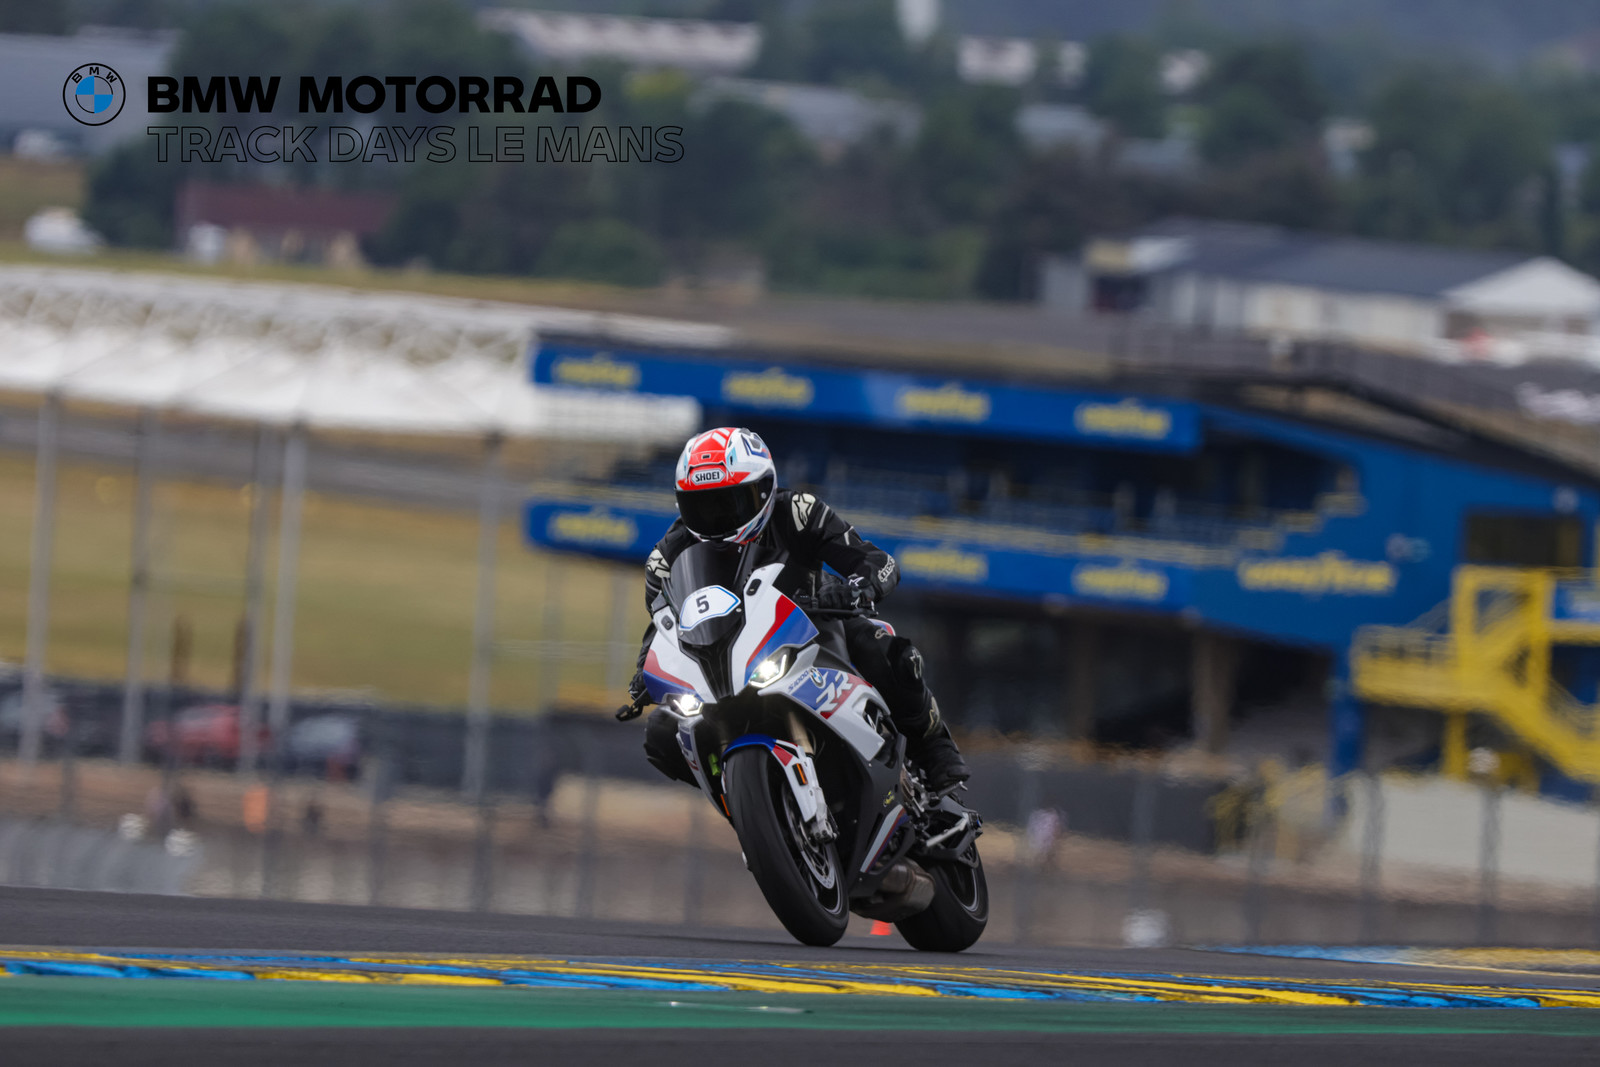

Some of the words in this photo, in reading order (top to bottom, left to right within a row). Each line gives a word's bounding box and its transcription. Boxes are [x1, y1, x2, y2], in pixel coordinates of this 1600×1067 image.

[695, 471, 720, 482] SHOEI
[695, 594, 710, 614] 5
[815, 670, 854, 713] RR
